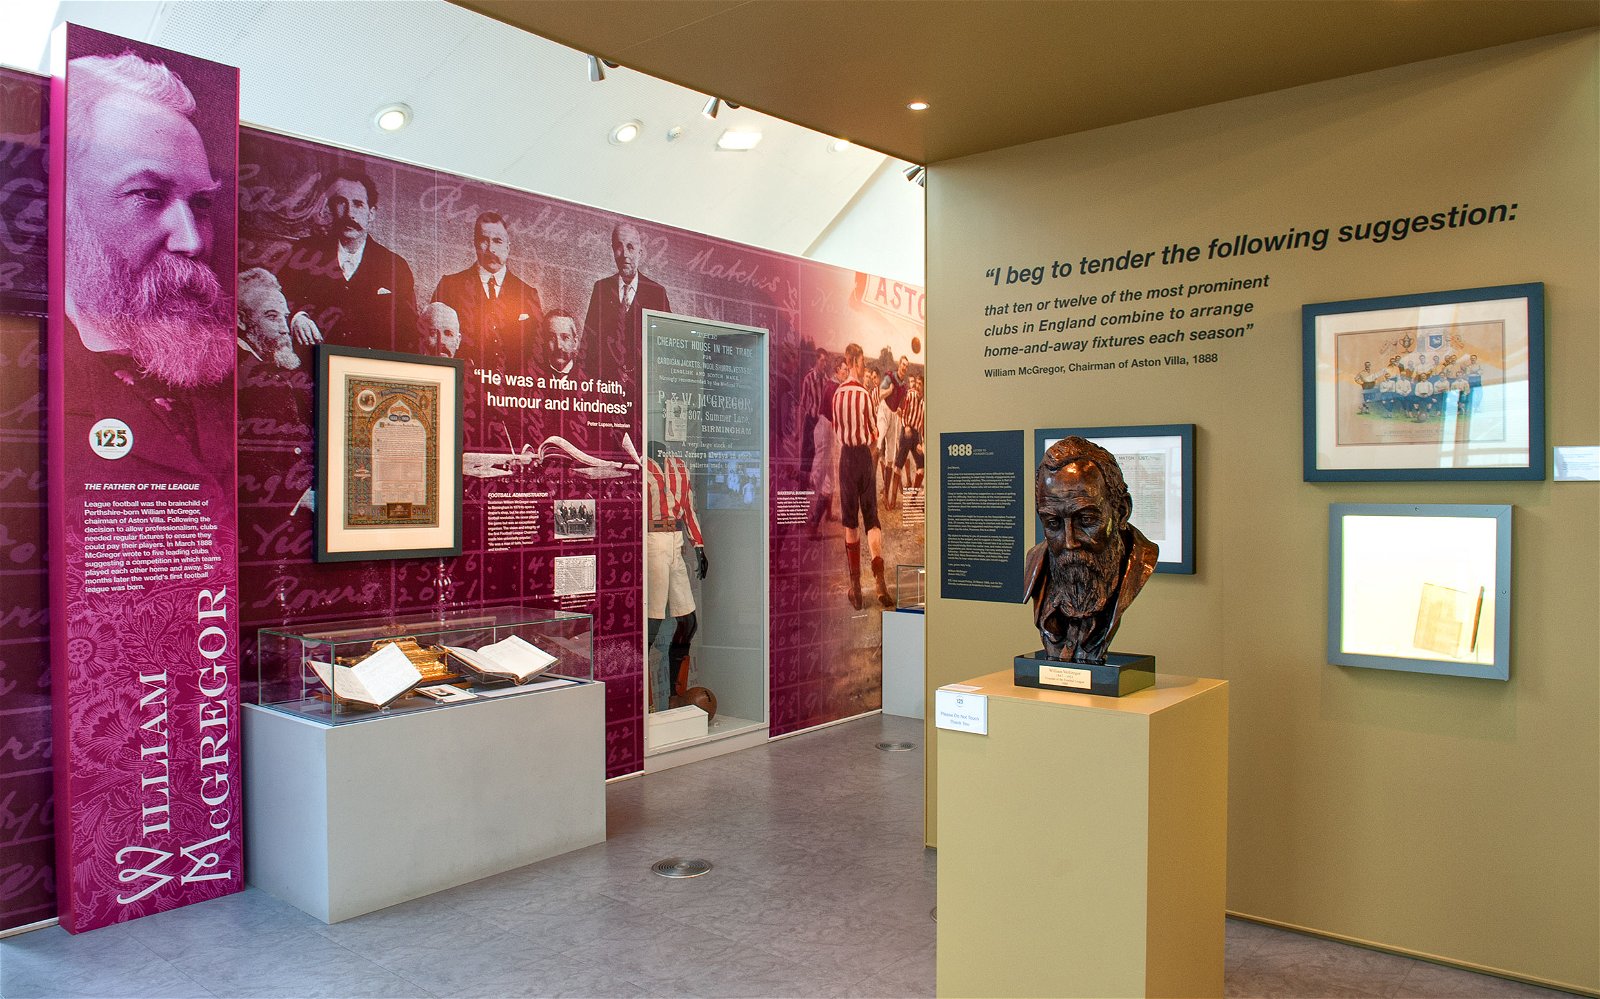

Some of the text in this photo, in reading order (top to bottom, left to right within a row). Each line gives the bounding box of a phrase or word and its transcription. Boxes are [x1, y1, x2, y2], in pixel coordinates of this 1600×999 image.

[1006, 266, 1045, 286] beg
[1051, 261, 1073, 279] to
[1080, 250, 1156, 275] tender
[1161, 245, 1201, 265] the
[1208, 228, 1329, 260] following
[1337, 203, 1518, 243] suggestion:
[984, 275, 1270, 317] that ten or twelve of the most prominent
[984, 302, 1254, 337] clubs in England combine to arrange
[657, 336, 688, 349] CHEAPEST
[692, 341, 711, 352] HOUSE
[714, 344, 720, 353] IN
[723, 346, 733, 355] THE
[984, 340, 1089, 357] home-and-away
[1092, 333, 1145, 349] fixtures
[1149, 330, 1185, 344] each
[984, 354, 1218, 378] William McGregor, Chairman of Aston Villa, 1888
[474, 369, 626, 397] “He was a man of faith,
[488, 392, 633, 415] humour and kindness”
[682, 393, 695, 406] W.
[706, 412, 731, 423] Summer
[95, 430, 127, 447] 125
[702, 425, 752, 435] BIRMINGHAM
[948, 444, 972, 456] 1888
[114, 534, 137, 542] regular
[85, 560, 124, 568] suggesting
[132, 558, 172, 566] competition
[85, 569, 109, 577] played
[117, 670, 174, 904] WILLIAM
